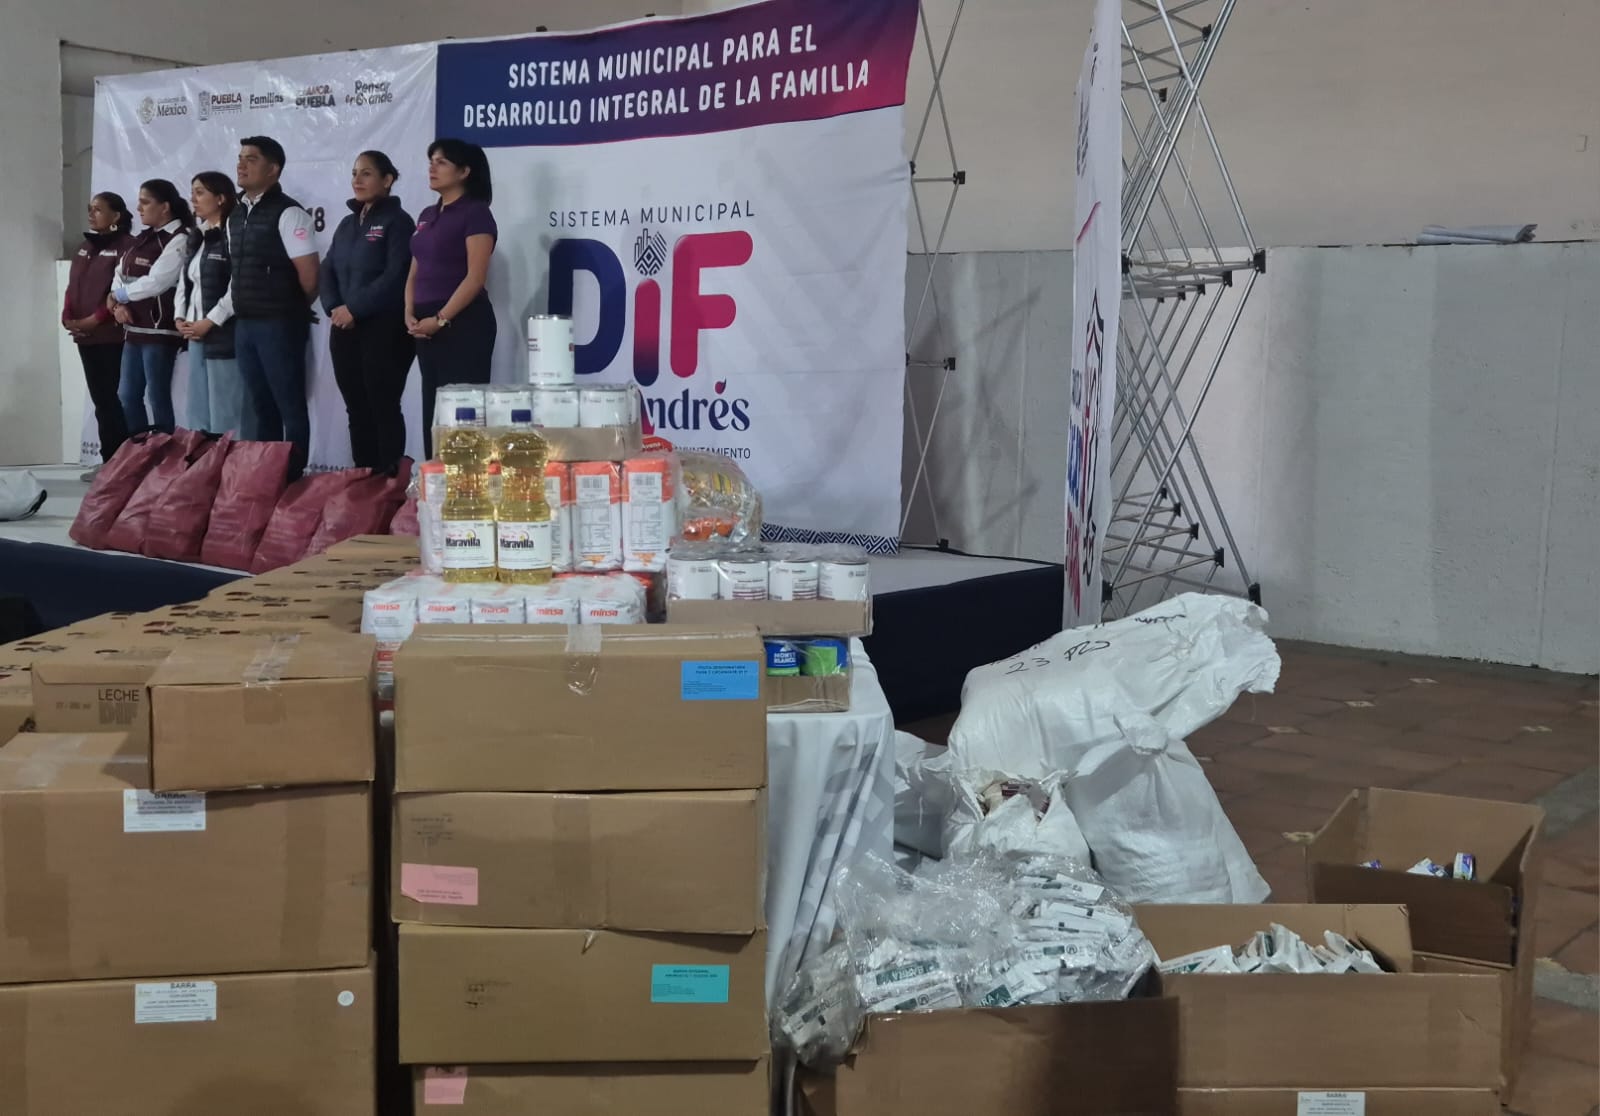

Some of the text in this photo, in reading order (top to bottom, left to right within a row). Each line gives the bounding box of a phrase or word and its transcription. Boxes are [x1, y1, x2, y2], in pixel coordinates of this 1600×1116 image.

[508, 24, 817, 88] SISTEMA MUNICIPAL PARA EL
[211, 93, 242, 104] PUEBLA
[250, 92, 284, 105] Familias
[463, 59, 870, 129] DESARROLLO INTEGRAL DE LA FAMILIA
[156, 104, 188, 117] México
[549, 200, 755, 227] SISTEMA MUNICIPAL
[445, 537, 481, 547] Maravilla
[500, 538, 534, 549] Maravilla
[536, 607, 564, 616] minsa
[590, 608, 618, 617] minsa
[98, 688, 140, 702] LECHE
